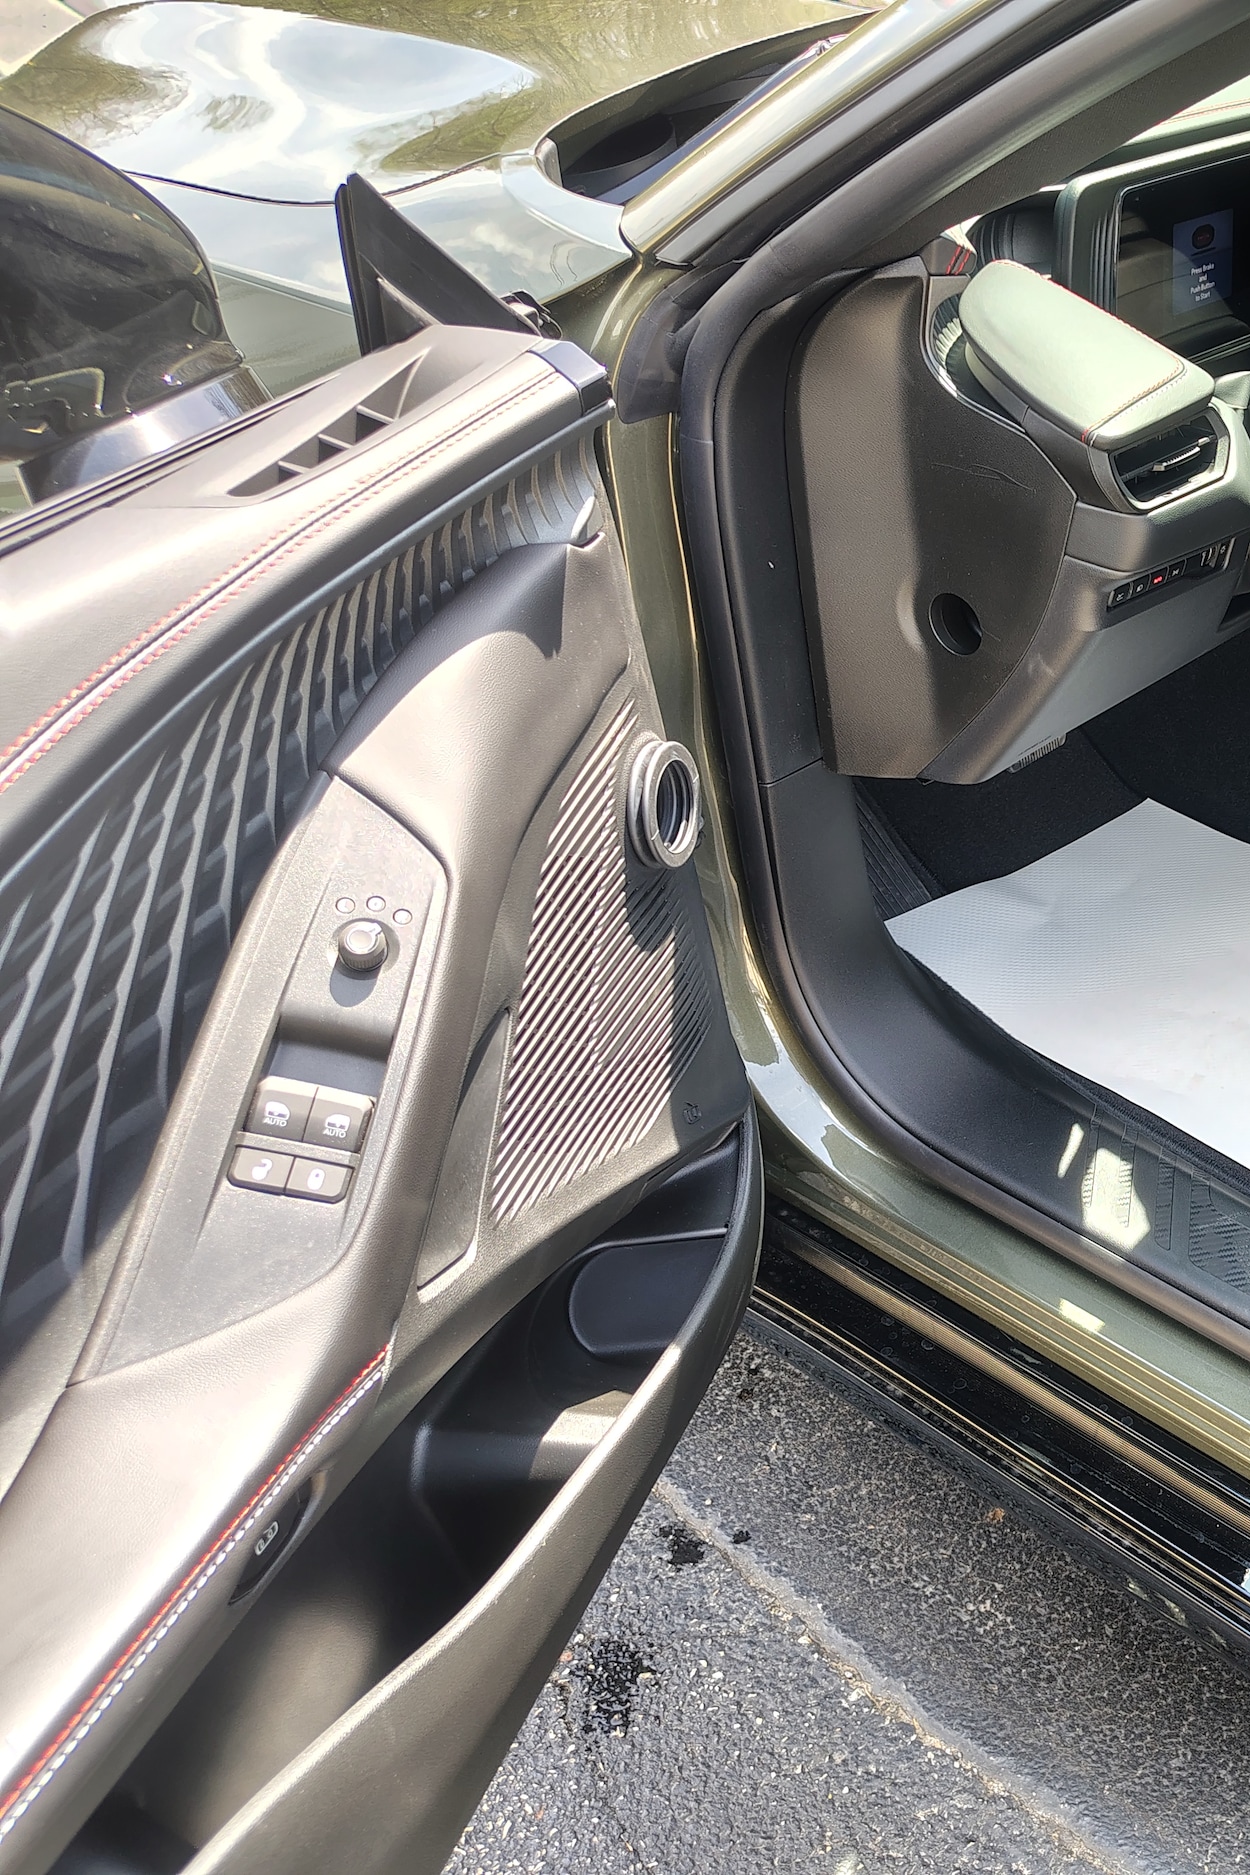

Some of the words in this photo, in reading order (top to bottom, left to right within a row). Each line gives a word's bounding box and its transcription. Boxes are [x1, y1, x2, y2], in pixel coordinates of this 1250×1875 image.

[1191, 268, 1202, 276] Press
[1203, 263, 1215, 272] Brake
[1199, 273, 1207, 282] and
[1190, 285, 1200, 294] Push
[1201, 282, 1215, 291] Button
[1200, 291, 1211, 300] Start
[263, 1117, 287, 1127] AUTO
[323, 1128, 346, 1138] AUTO
